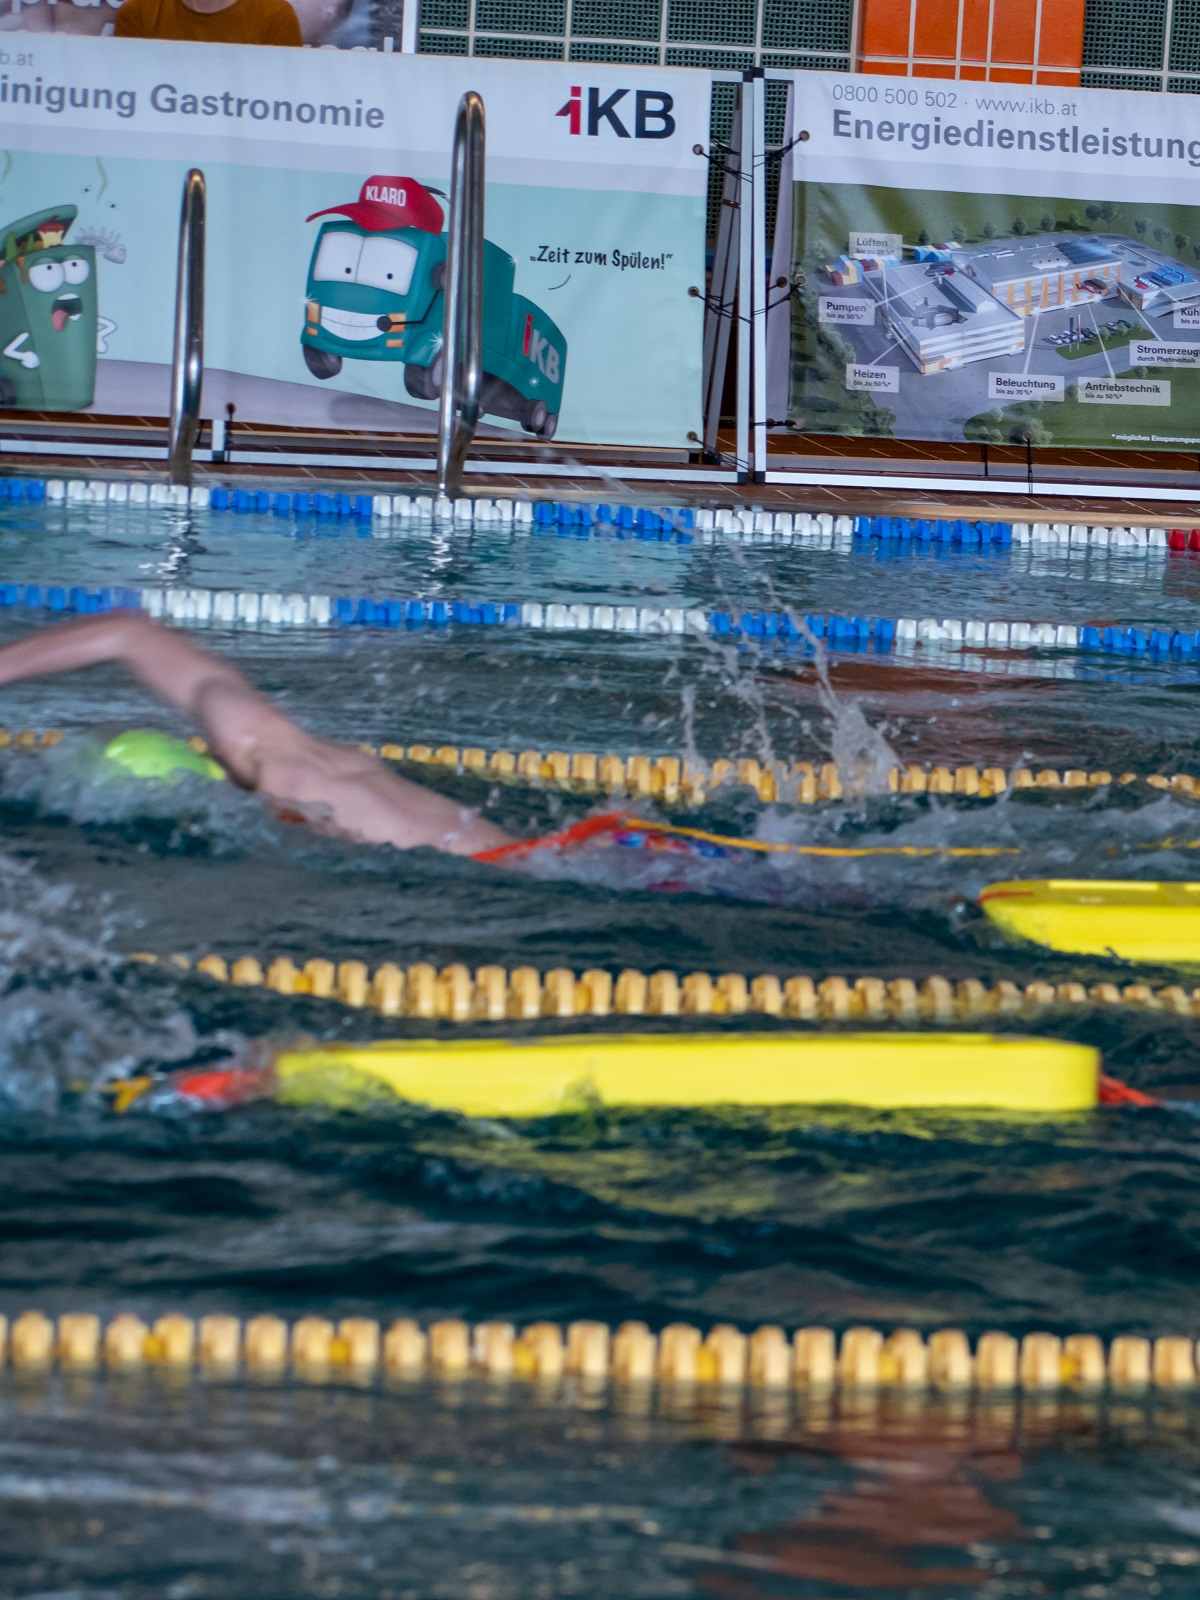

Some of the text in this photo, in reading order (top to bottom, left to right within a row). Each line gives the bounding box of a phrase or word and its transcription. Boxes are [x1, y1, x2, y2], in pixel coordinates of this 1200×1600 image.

[150, 84, 385, 129] Gastronomie
[832, 84, 1077, 117] 0800 500 502 www.ikb.at
[554, 86, 676, 139] iKB
[366, 185, 406, 207] KLARO
[857, 238, 888, 247] Lüften
[574, 251, 607, 266] zum
[826, 301, 867, 313] Pumpen
[522, 312, 560, 384] iKB
[853, 369, 886, 379] Heizen
[995, 378, 1056, 391] Beleuchtung
[1085, 382, 1161, 394] Antriebstechnik
